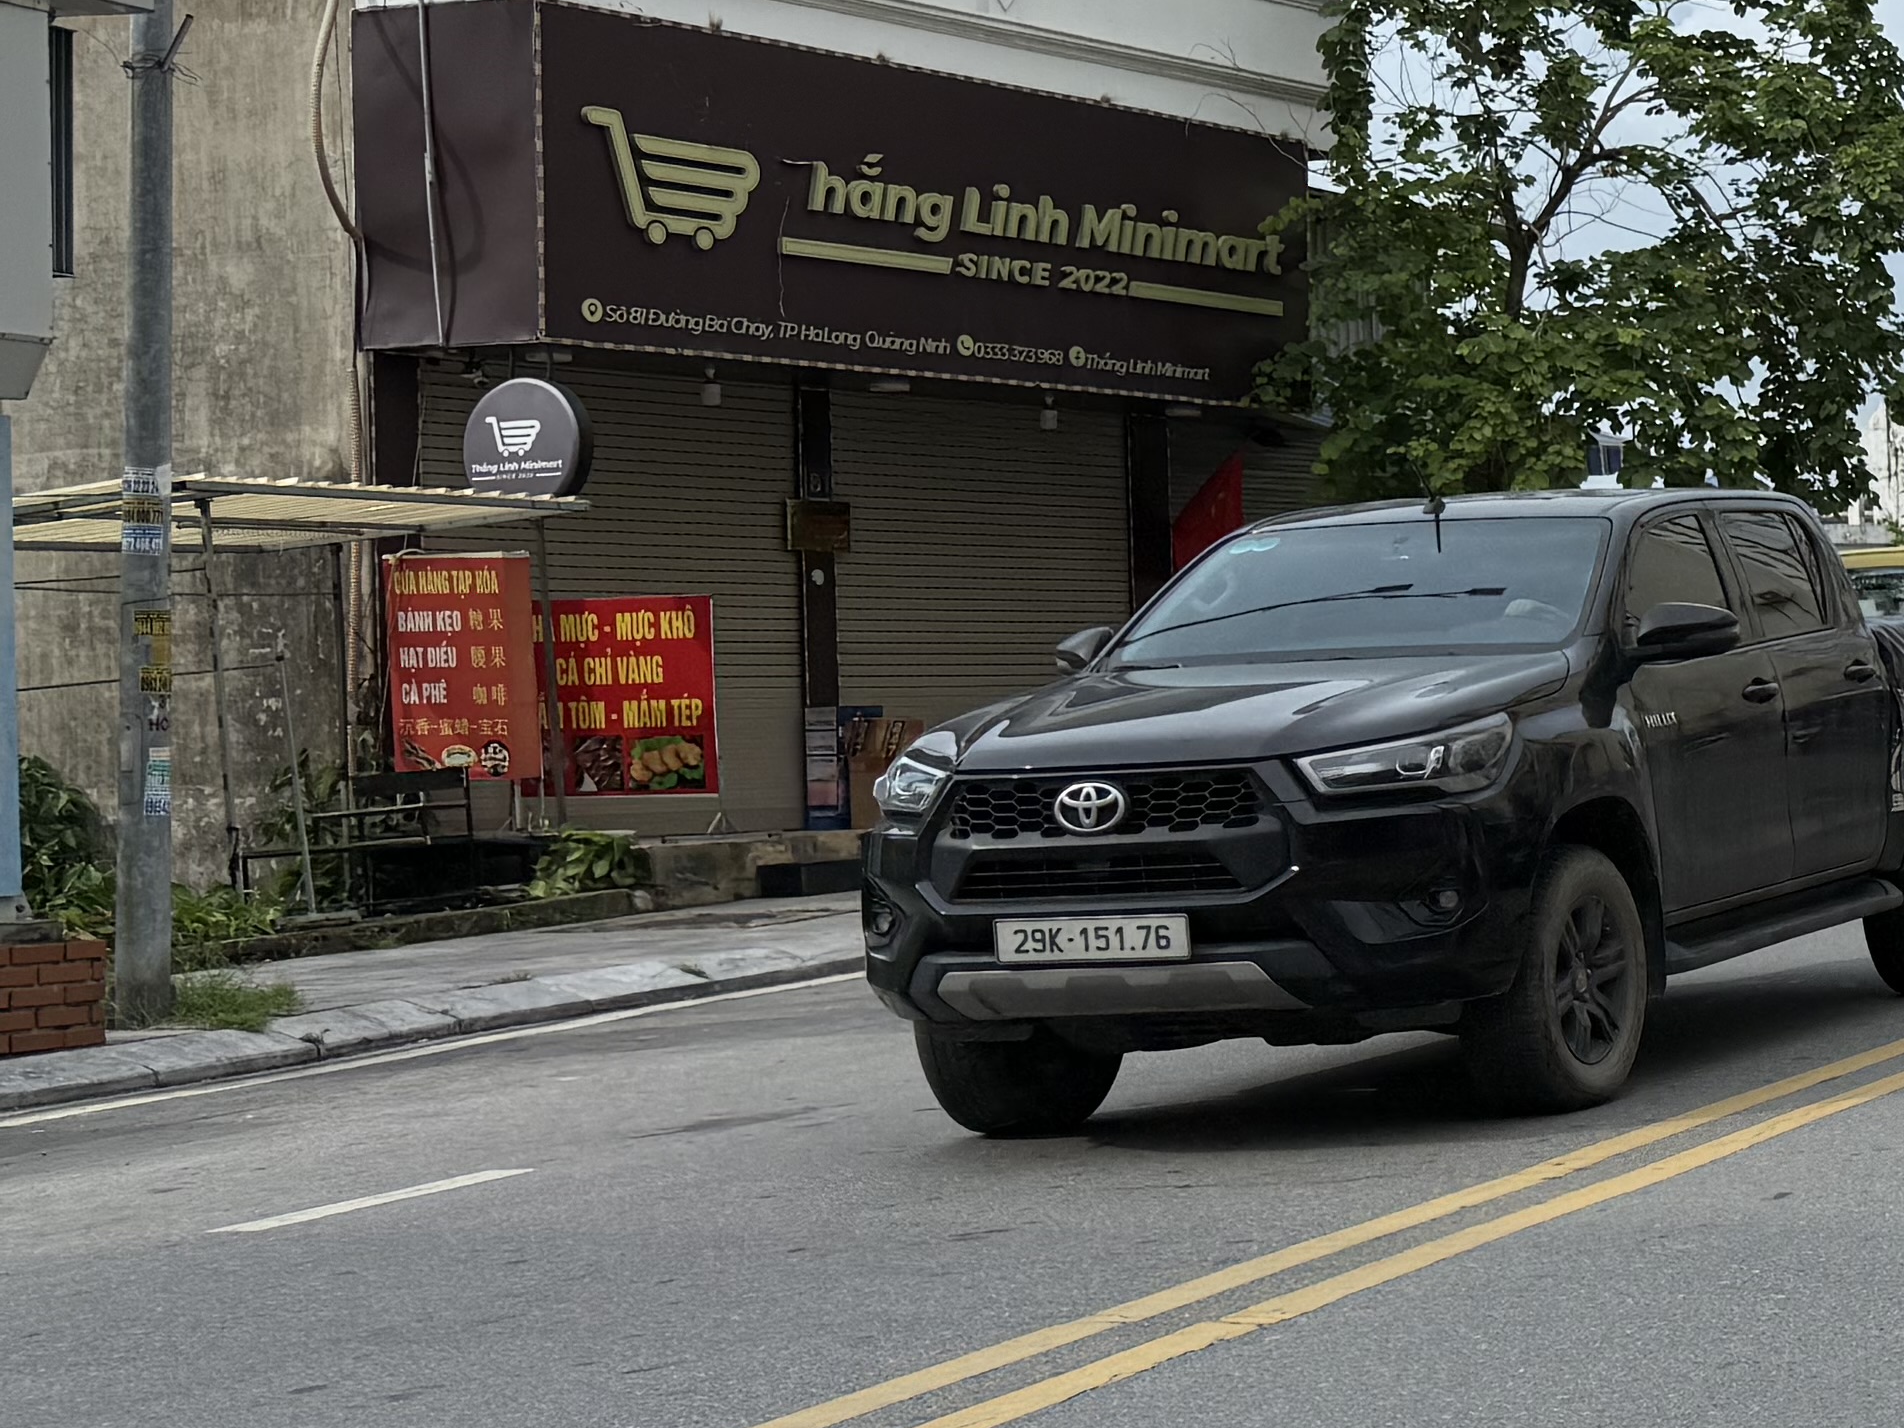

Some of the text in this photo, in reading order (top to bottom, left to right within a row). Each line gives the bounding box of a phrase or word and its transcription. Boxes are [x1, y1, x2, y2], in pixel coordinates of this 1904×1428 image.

[960, 184, 1069, 246] Linh
[1075, 204, 1285, 275] Minimart
[956, 253, 1128, 296] SINCE 2022
[777, 320, 798, 339] TP
[974, 341, 1009, 360] 0333
[1010, 344, 1036, 363] 373
[1037, 348, 1064, 365] 968
[615, 609, 655, 647] MỰC
[660, 604, 695, 640] KHÔ
[616, 650, 664, 685] VÀNG
[402, 678, 419, 705] CÀ
[671, 692, 703, 727] TÉP
[1013, 924, 1171, 954] 29K-151.76
